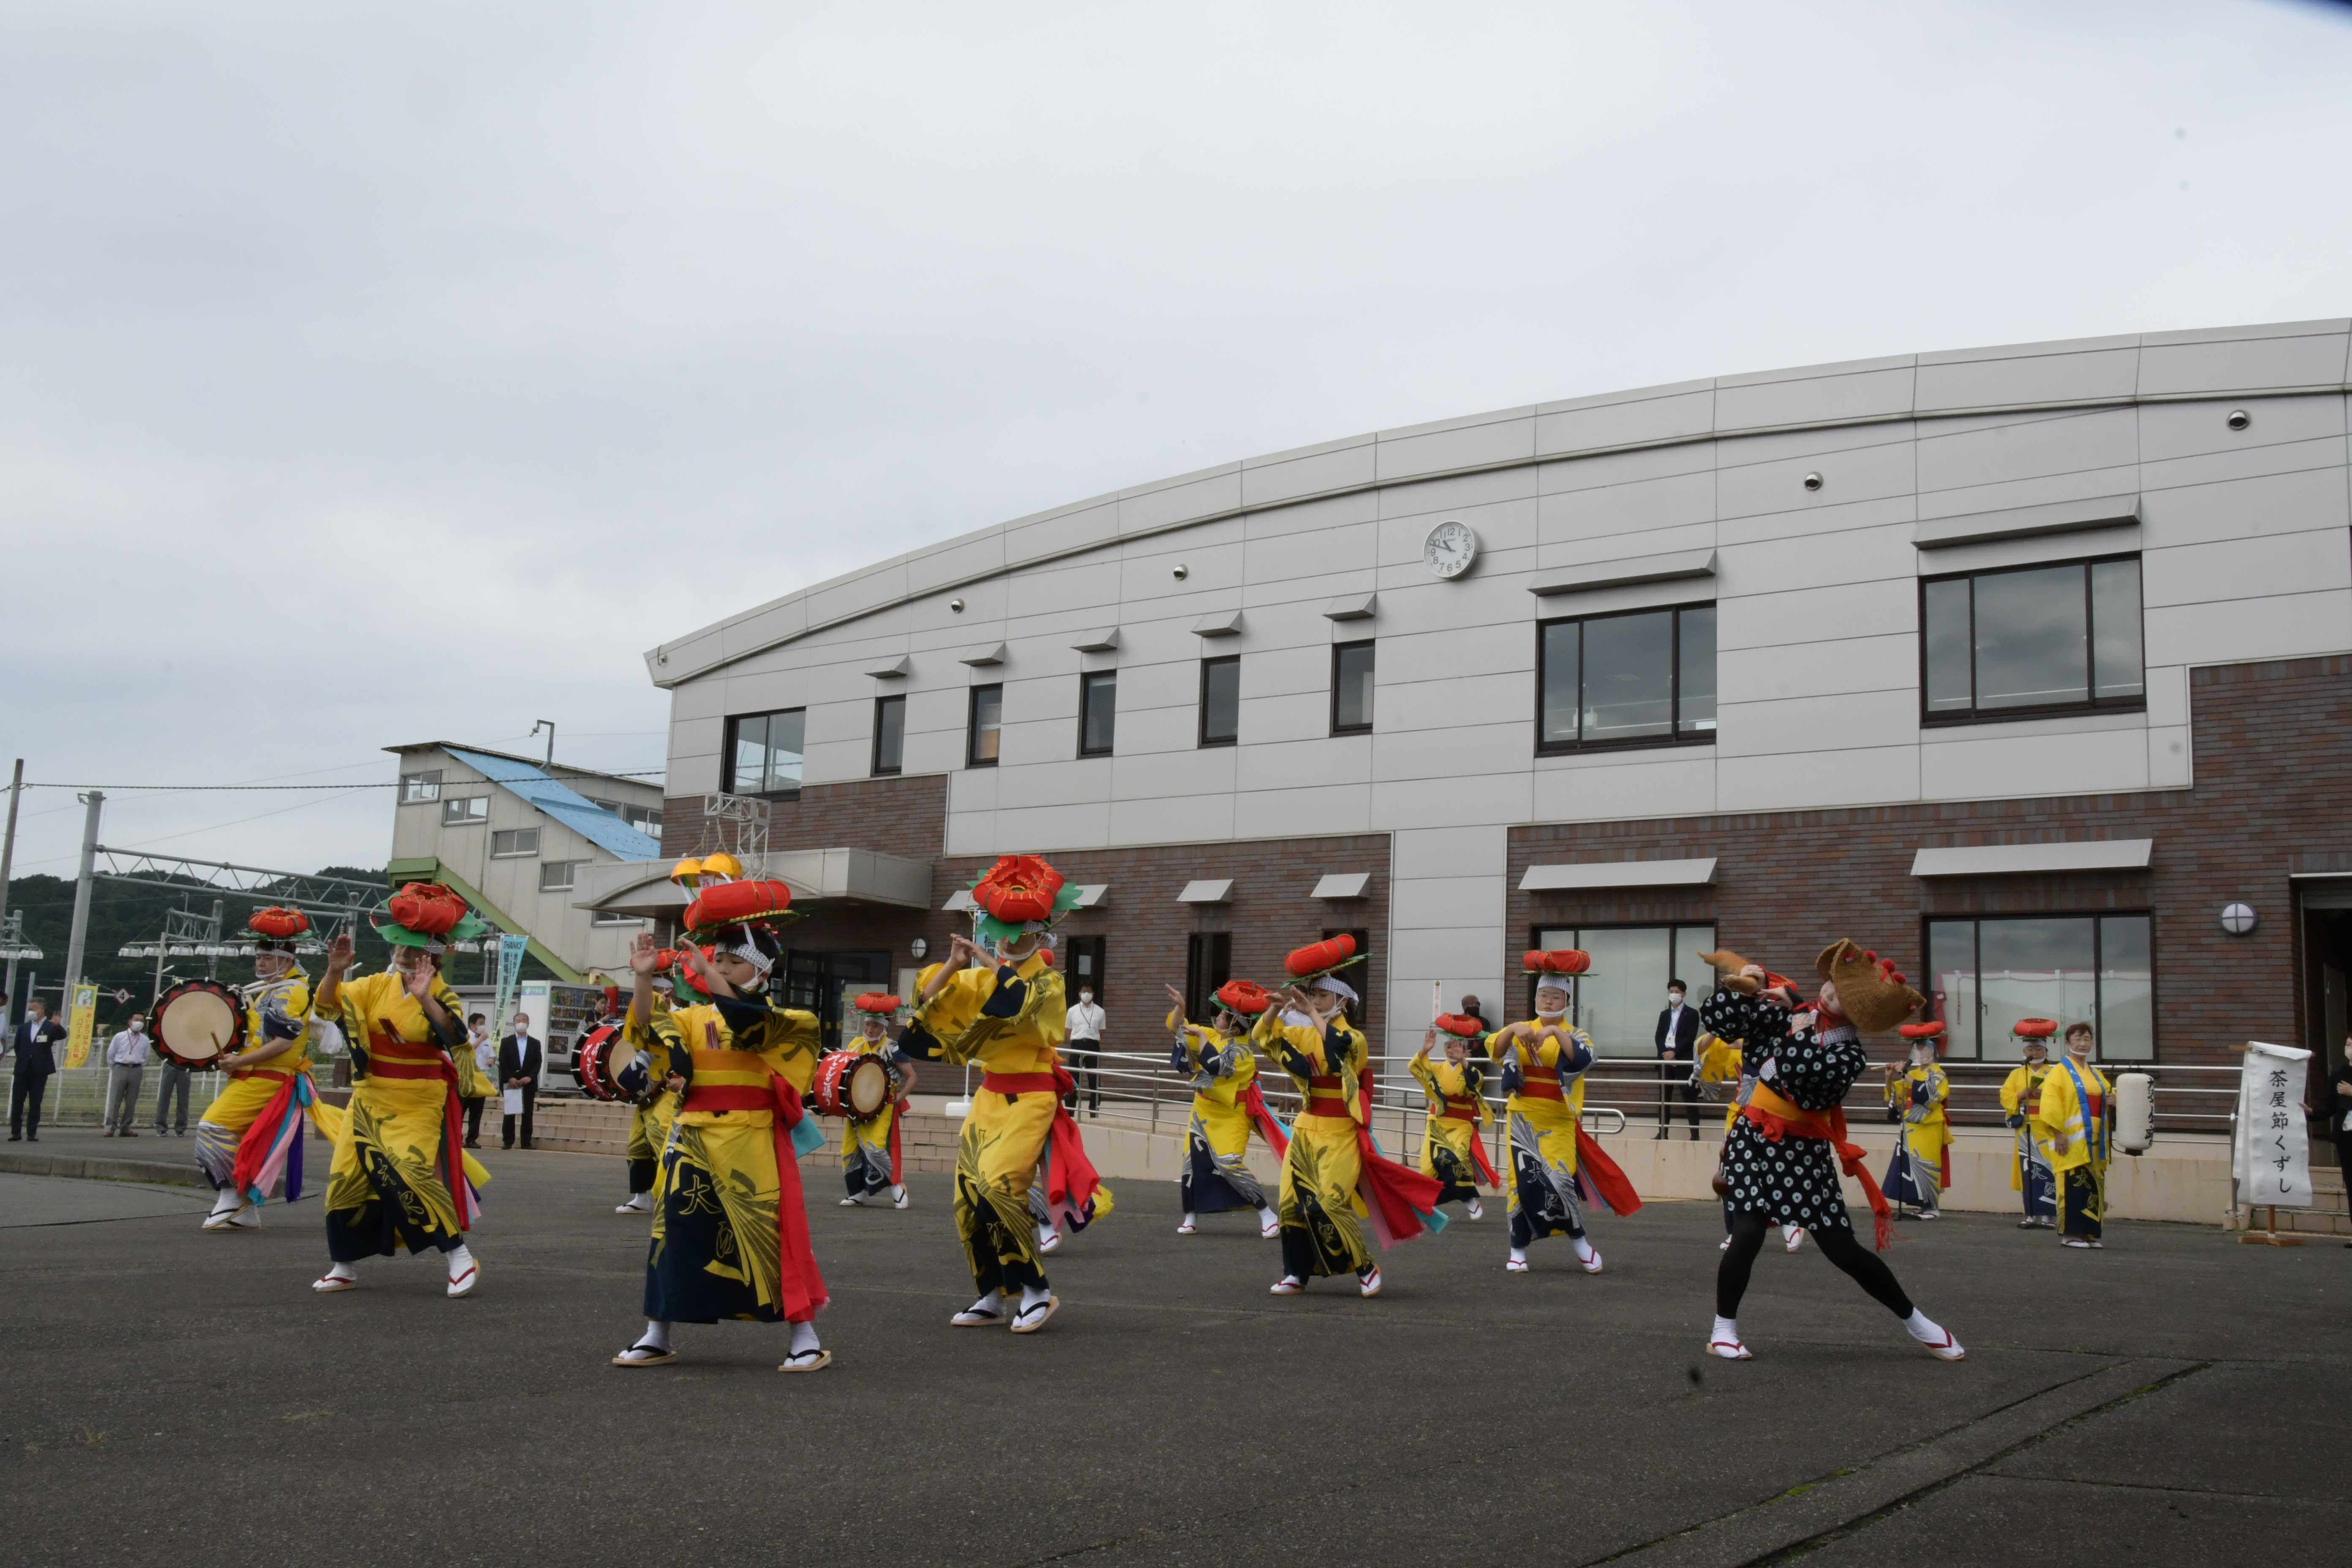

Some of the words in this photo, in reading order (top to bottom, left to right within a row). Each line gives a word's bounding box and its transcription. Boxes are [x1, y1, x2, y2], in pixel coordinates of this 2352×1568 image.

[1440, 530, 1446, 539] 11
[1448, 528, 1455, 536] 12
[1463, 534, 1468, 542] 2
[1465, 543, 1470, 551] 3
[1430, 548, 1436, 556] 9
[1433, 556, 1438, 564] 8
[1456, 560, 1461, 568] 5
[1447, 564, 1452, 572] 6
[119, 992, 125, 1000] 4
[2269, 1070, 2292, 1193] 茶屋節くずし
